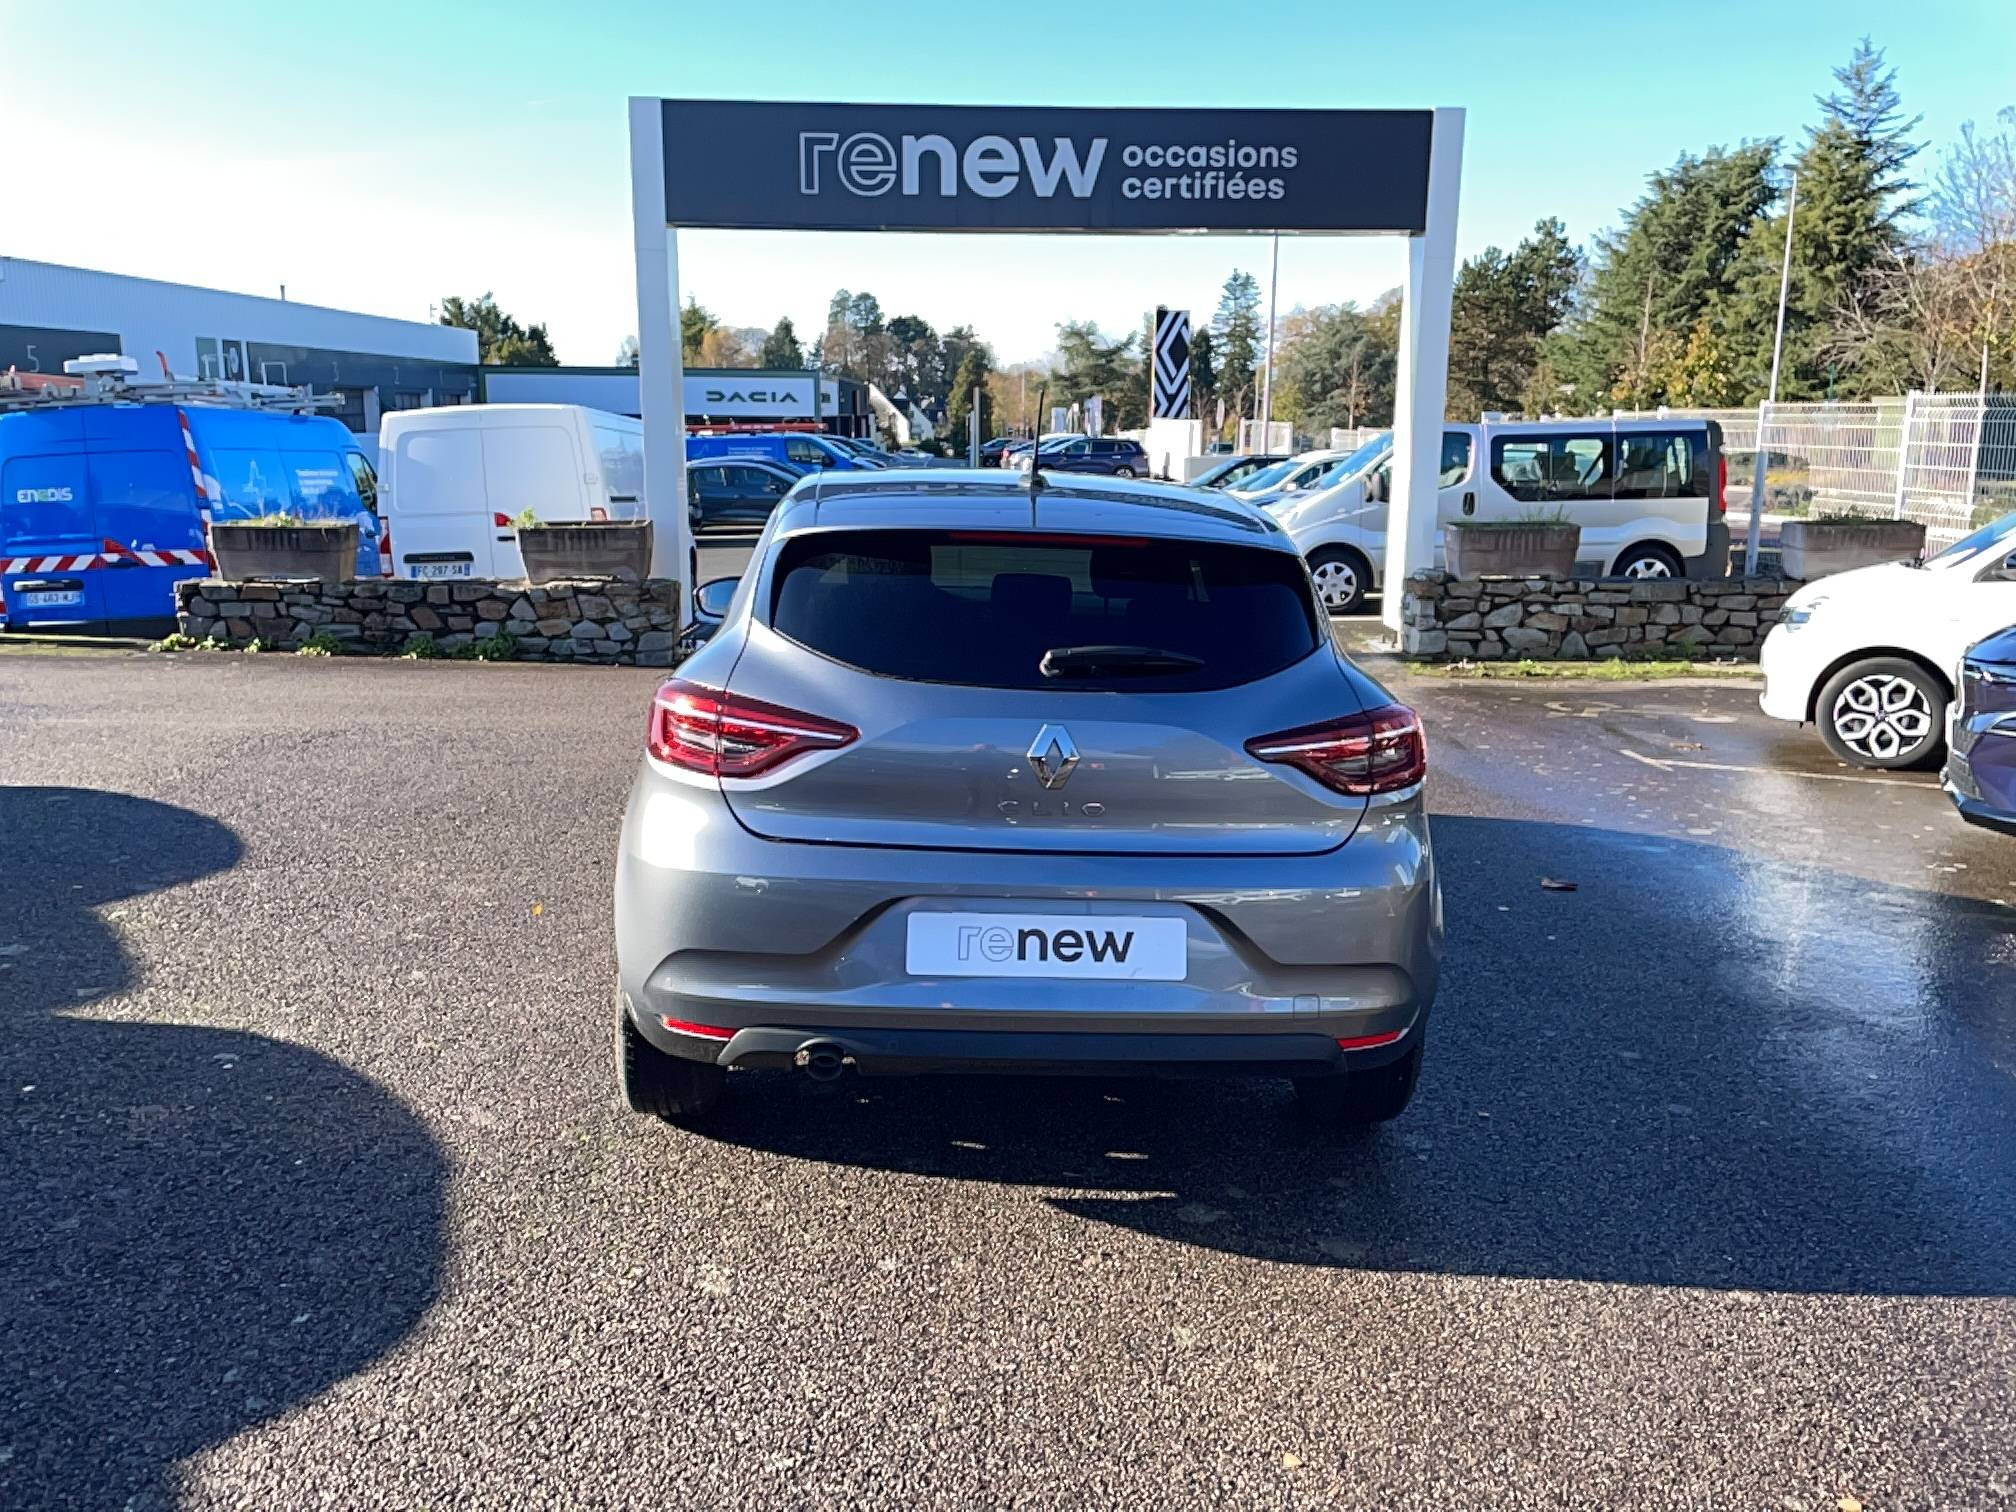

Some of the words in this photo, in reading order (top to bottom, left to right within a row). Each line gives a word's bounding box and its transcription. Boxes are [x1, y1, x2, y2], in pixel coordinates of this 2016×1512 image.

[799, 131, 1108, 199] renew
[1122, 139, 1299, 168] occasions
[1122, 171, 1286, 200] certifiées
[26, 344, 40, 373] 5
[706, 390, 798, 402] DACIA
[997, 799, 1106, 818] CLIO
[957, 925, 1136, 964] renew
